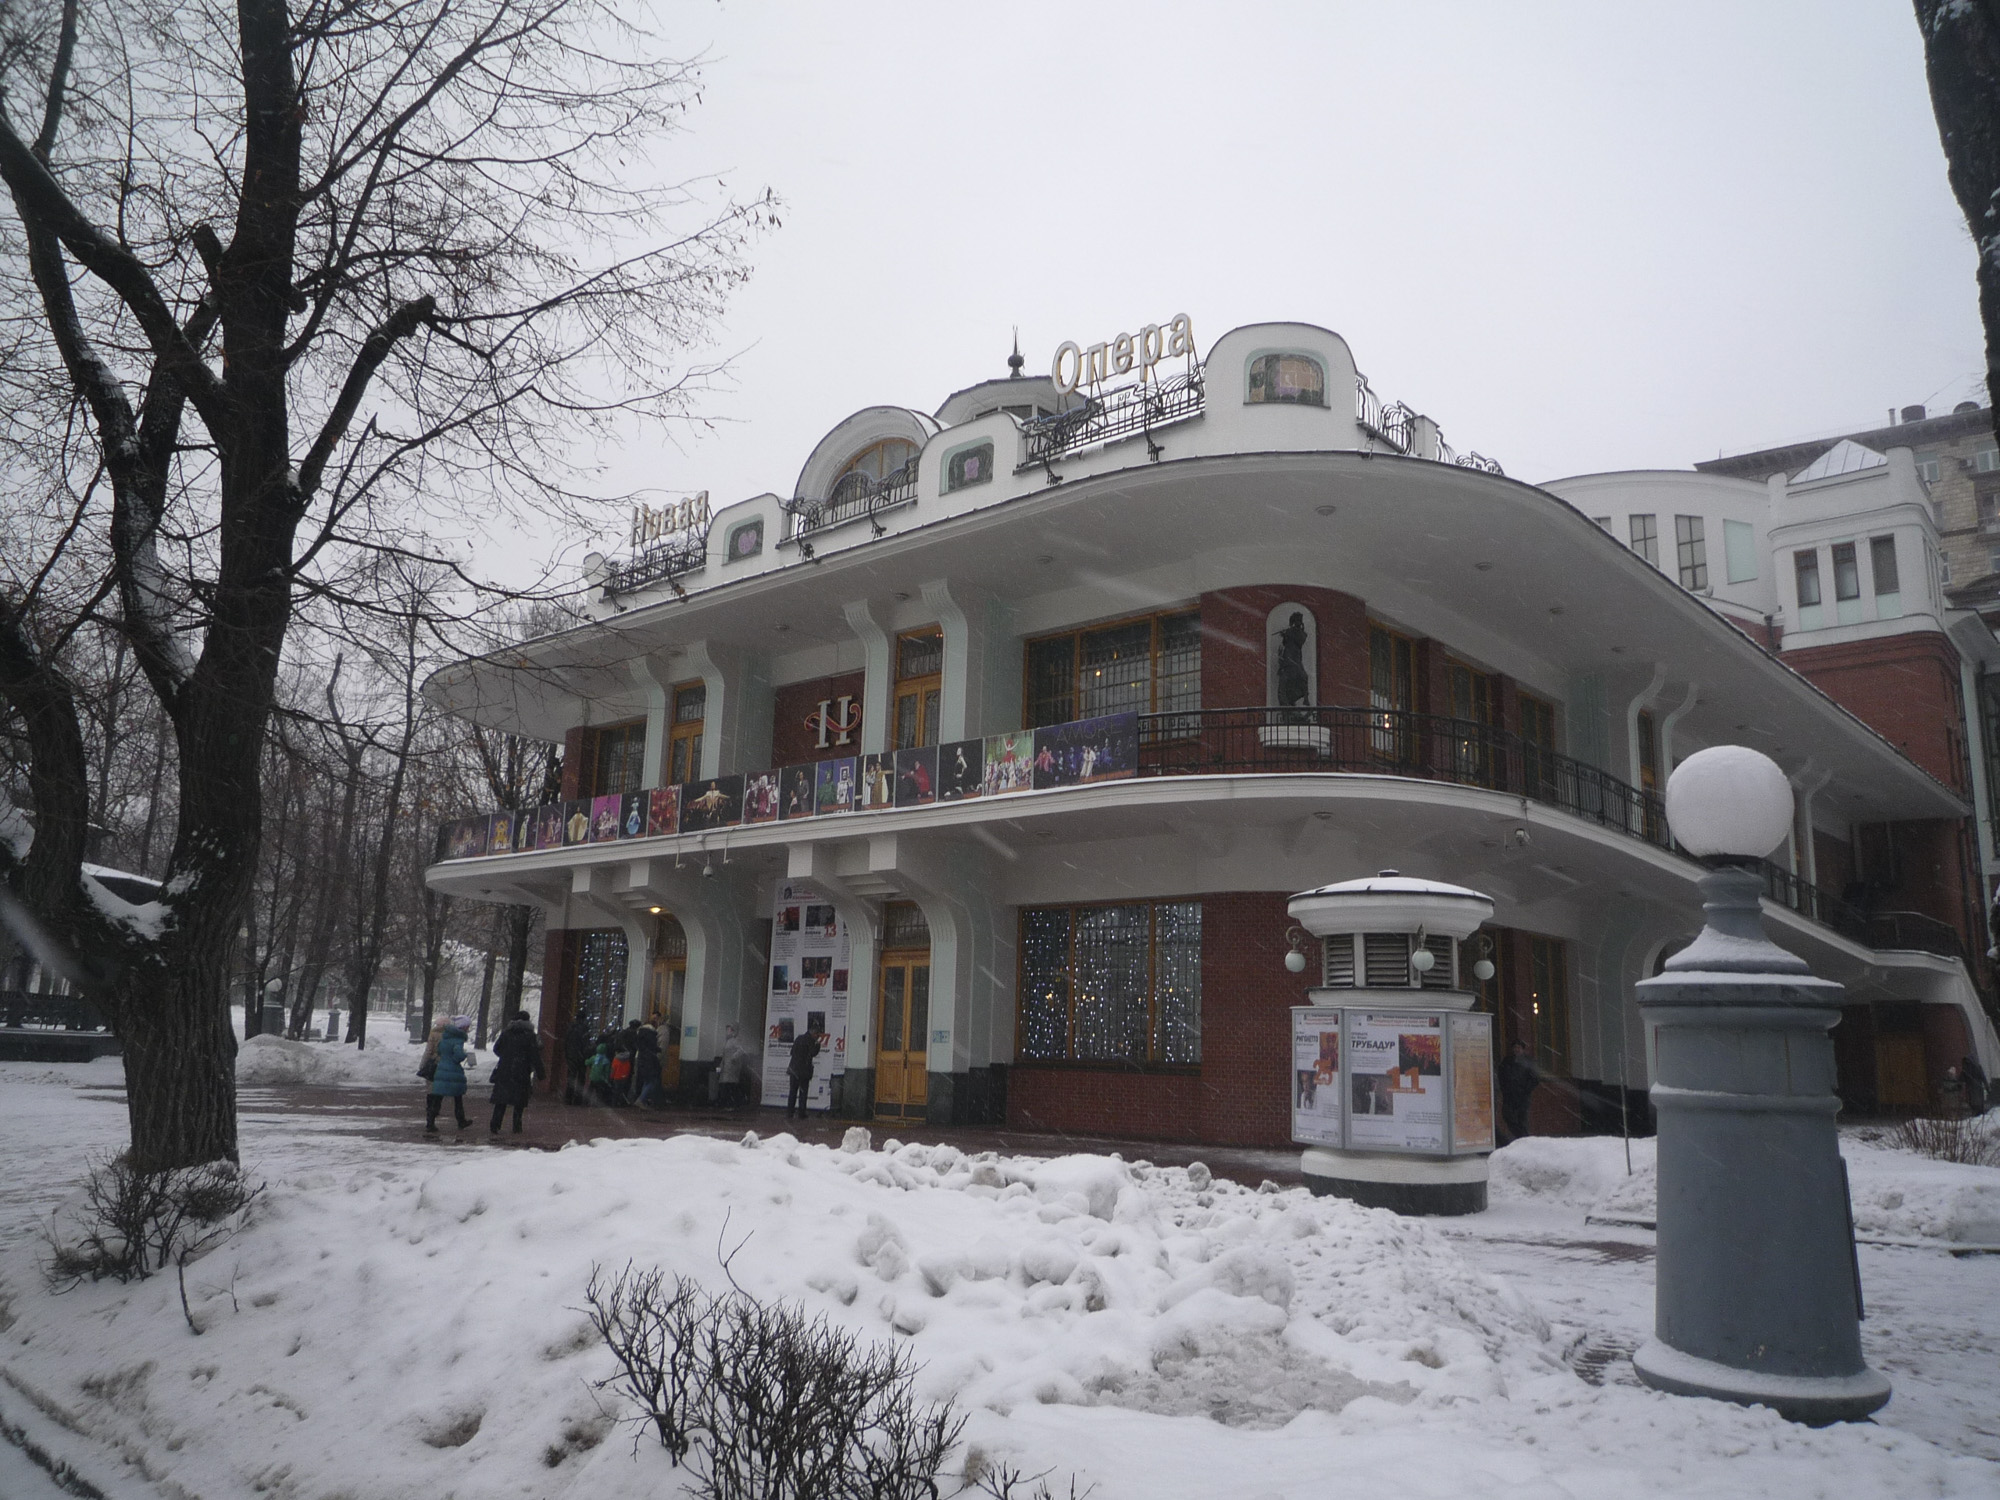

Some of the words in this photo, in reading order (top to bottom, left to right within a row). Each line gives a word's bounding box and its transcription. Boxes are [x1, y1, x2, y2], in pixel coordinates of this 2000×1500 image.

[630, 490, 709, 547] Новая
[1052, 313, 1192, 396] Опера
[1351, 1040, 1396, 1051] ТРУБАДУР
[1386, 1066, 1425, 1094] 11
